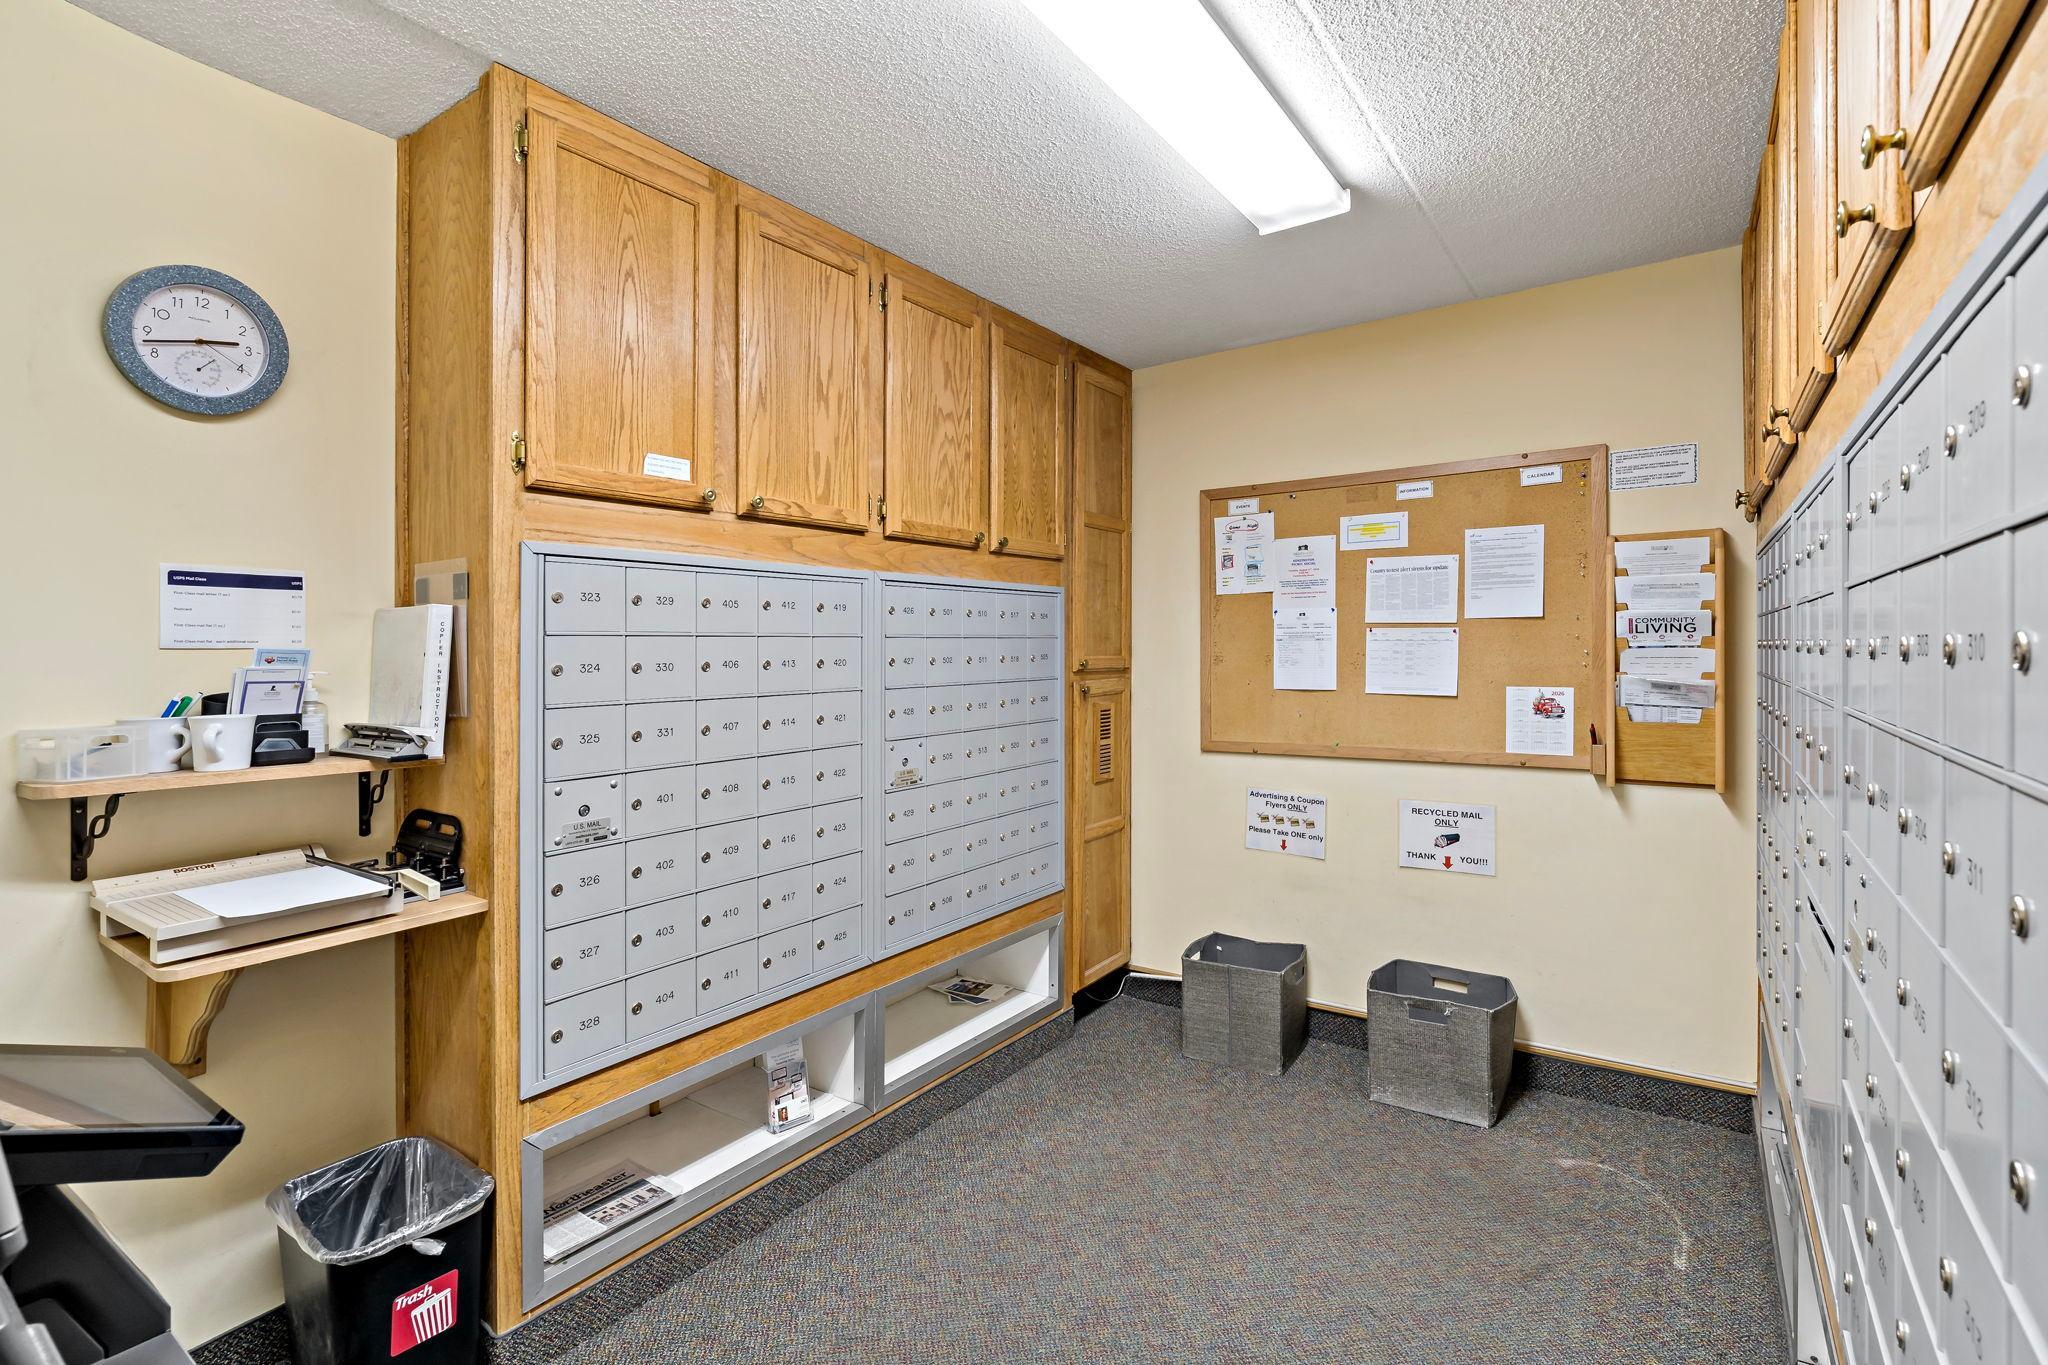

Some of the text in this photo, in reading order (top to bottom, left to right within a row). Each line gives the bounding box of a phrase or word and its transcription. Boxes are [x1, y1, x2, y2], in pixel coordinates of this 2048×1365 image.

[172, 297, 184, 308] 11
[195, 297, 210, 309] 12
[152, 307, 171, 321] 10
[224, 310, 230, 319] 1
[142, 325, 153, 336] 9
[238, 325, 247, 336] 2
[150, 347, 159, 358] 8
[244, 346, 253, 357] 3
[236, 364, 244, 373] 4
[1968, 400, 1986, 437] 309
[581, 593, 600, 602] 323
[656, 597, 673, 605] 329
[723, 600, 739, 608] 405
[977, 609, 987, 617] 510
[1635, 616, 1697, 624] COMMUNITY
[1635, 623, 1697, 634] LIVING
[1967, 633, 1985, 661] 310
[580, 664, 600, 673] 324
[656, 663, 674, 672] 330
[723, 660, 739, 668] 406
[781, 718, 795, 726] 414
[834, 714, 845, 722] 421
[723, 722, 738, 731] 407
[657, 728, 673, 737] 331
[580, 734, 600, 744] 325
[978, 747, 987, 755] 513
[834, 769, 846, 777] 422
[781, 776, 795, 784] 415
[722, 784, 738, 792] 408
[657, 793, 673, 803] 401
[1250, 791, 1288, 802] Advertising
[1297, 796, 1325, 806] Coupon
[1266, 801, 1308, 812] Flyers ONLY
[1411, 807, 1483, 820] RECYCLED MAIL
[574, 822, 585, 831] U.S.
[587, 820, 601, 828] MAIL
[834, 823, 846, 832] 423
[1434, 819, 1459, 827] ONLY
[1915, 815, 1927, 842] 304
[782, 834, 795, 843] 416
[1249, 825, 1324, 843] Please Take ONE only
[723, 845, 738, 855] 409
[943, 848, 952, 856] 507
[1407, 851, 1437, 860] THANK
[656, 859, 674, 870] 402
[903, 858, 914, 867] 430
[1460, 857, 1488, 866] YOU!!!
[173, 864, 215, 874] BOSTON
[1967, 857, 1984, 894] 311
[580, 875, 599, 887] 326
[834, 877, 846, 886] 424
[782, 892, 795, 902] 417
[723, 907, 739, 918] 410
[904, 909, 913, 917] 431
[656, 925, 674, 937] 403
[834, 931, 847, 941] 425
[580, 945, 599, 959] 327
[782, 948, 796, 958] 418
[724, 969, 738, 980] 411
[656, 991, 674, 1004] 404
[580, 1016, 600, 1030] 328
[396, 1284, 432, 1311] Trash
